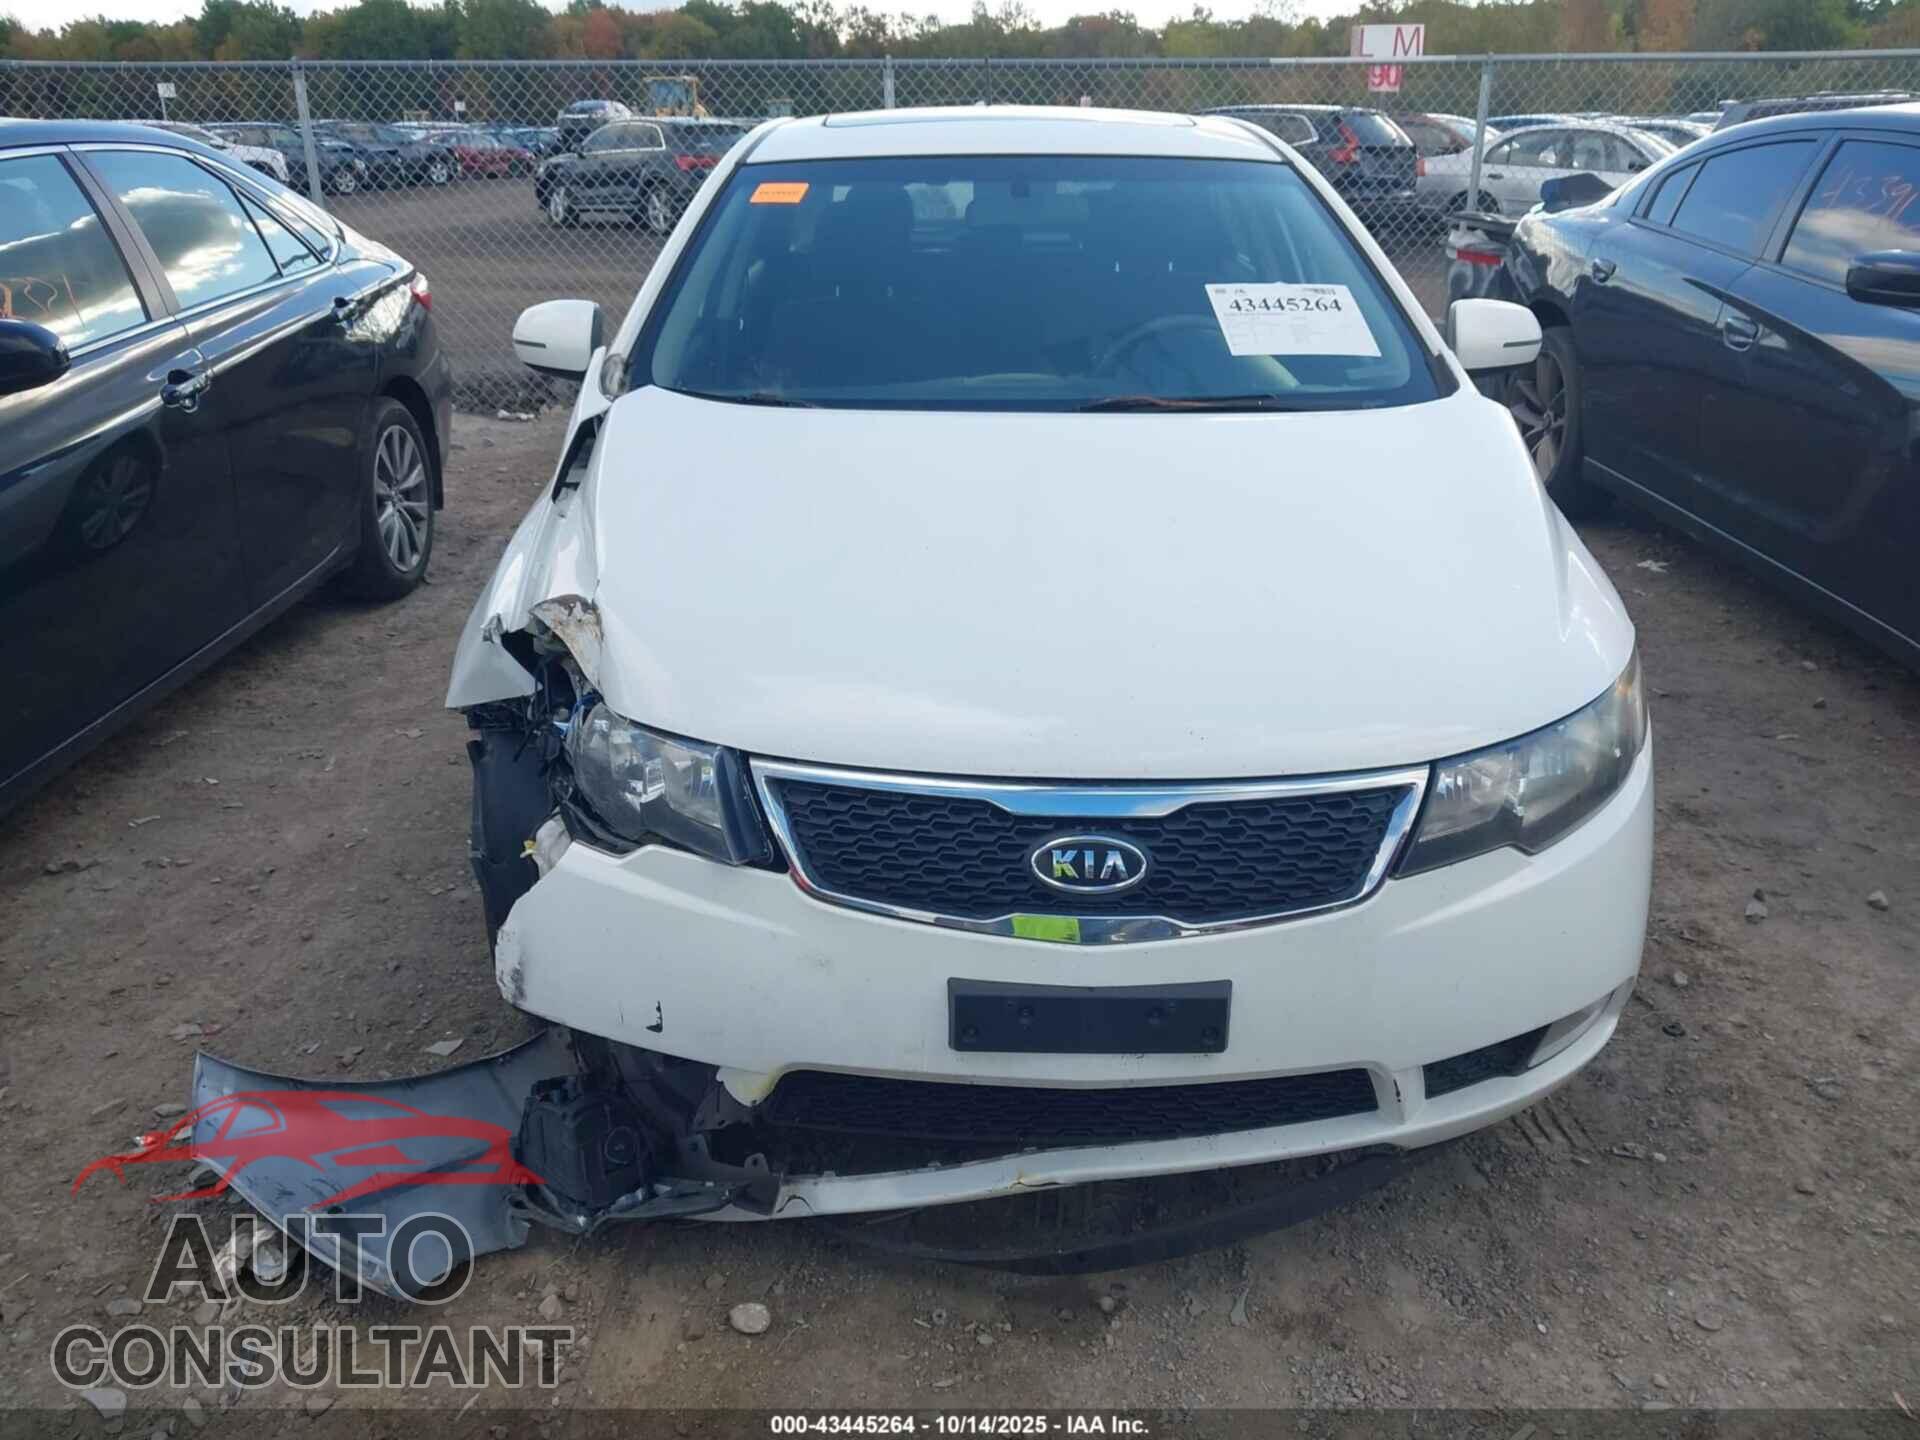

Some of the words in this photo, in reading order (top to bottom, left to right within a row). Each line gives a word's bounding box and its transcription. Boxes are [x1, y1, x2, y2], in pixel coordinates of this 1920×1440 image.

[1360, 27, 1375, 57] L
[1393, 26, 1420, 57] M
[1229, 297, 1343, 313] 43445264
[1051, 849, 1129, 879] KIA
